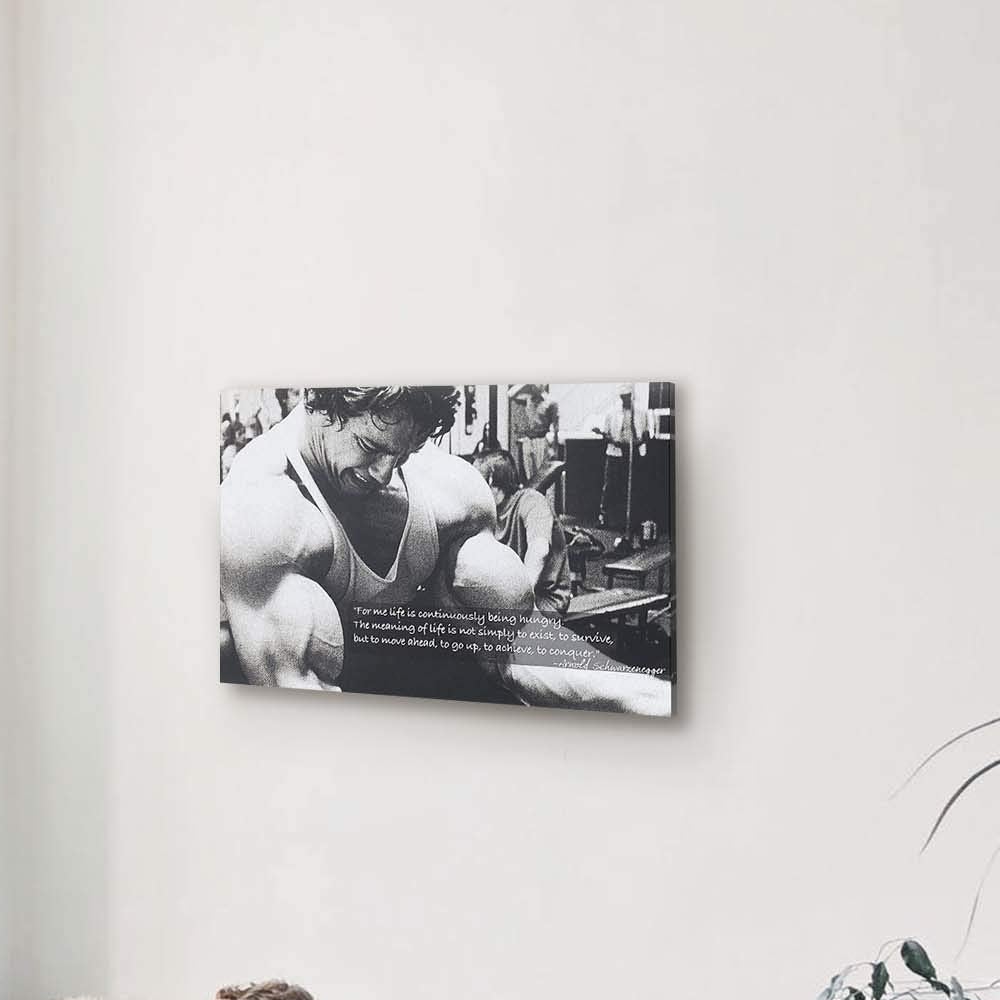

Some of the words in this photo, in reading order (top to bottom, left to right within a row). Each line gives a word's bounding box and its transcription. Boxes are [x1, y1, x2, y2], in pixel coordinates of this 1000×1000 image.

[373, 608, 388, 616] me
[389, 606, 406, 620] life
[407, 607, 416, 618] is
[418, 608, 485, 626] continuously
[488, 611, 517, 626] being
[353, 620, 370, 630] The
[371, 621, 416, 635] meaning
[417, 622, 429, 636] of
[429, 623, 446, 637] life
[447, 623, 457, 635] is
[459, 627, 476, 636] not
[477, 625, 515, 642] simply
[517, 629, 528, 639] to
[558, 632, 570, 641] to
[571, 631, 615, 645] survive,
[353, 633, 369, 643] but
[370, 635, 380, 644] to
[381, 637, 406, 646] move
[407, 637, 438, 649] ahead,
[440, 639, 450, 649] to
[451, 642, 464, 652] go
[465, 643, 482, 654] up,
[483, 643, 494, 652] to
[495, 643, 535, 656] achieve,
[536, 645, 547, 655] to
